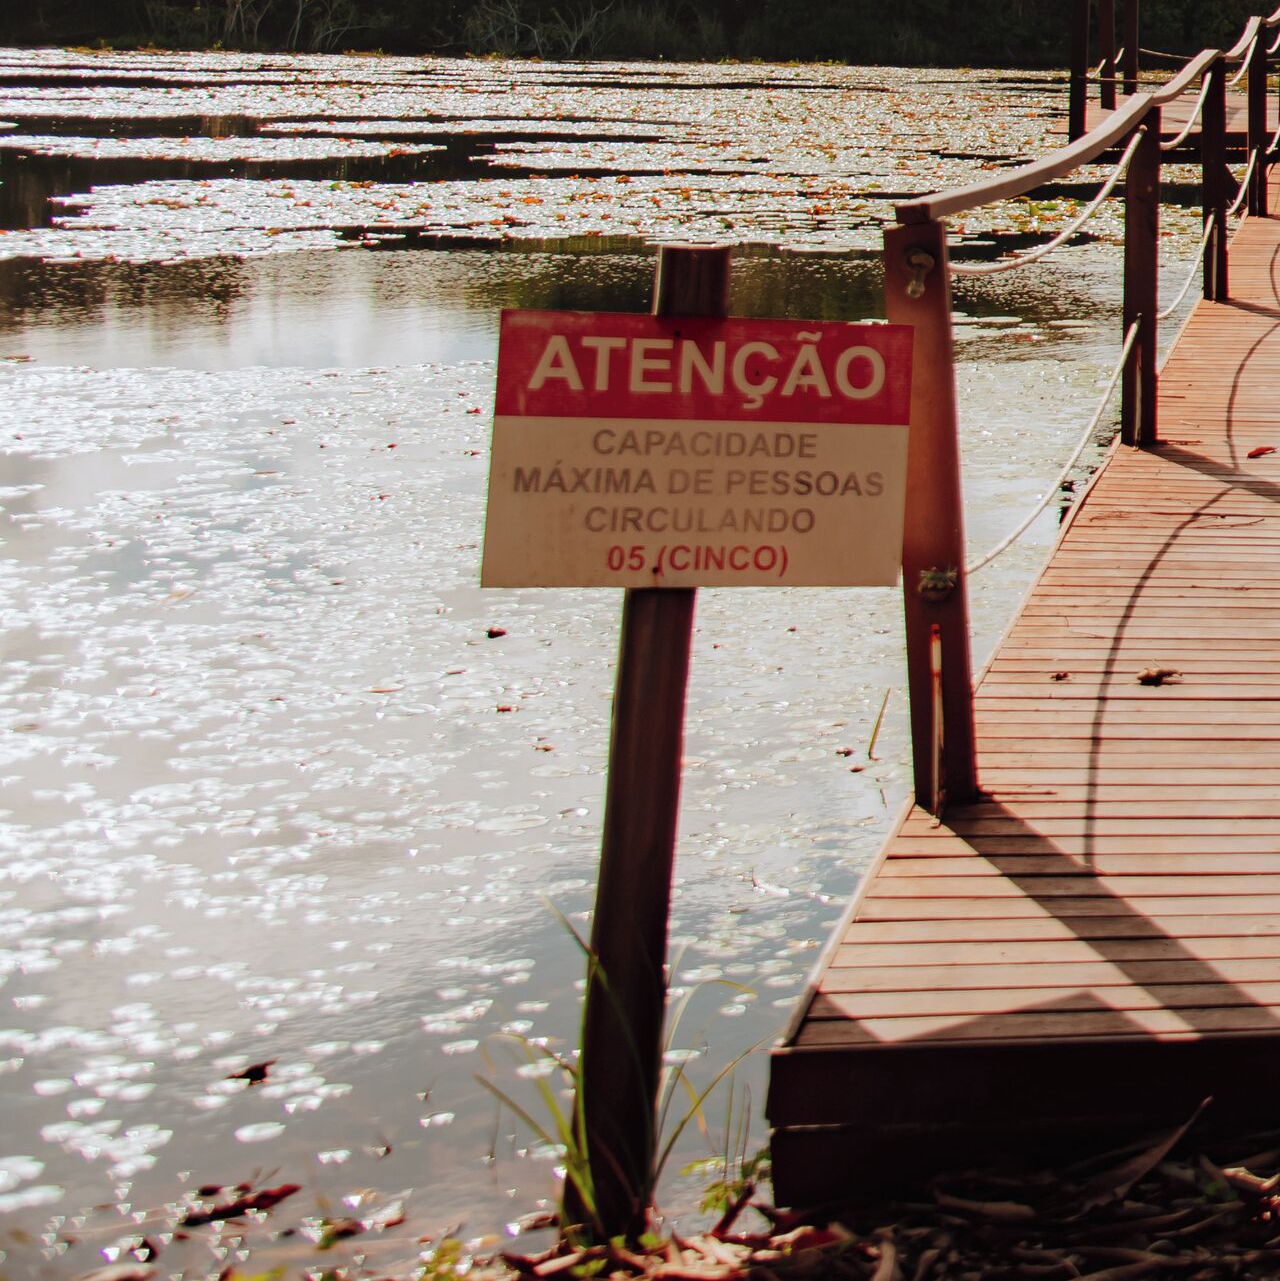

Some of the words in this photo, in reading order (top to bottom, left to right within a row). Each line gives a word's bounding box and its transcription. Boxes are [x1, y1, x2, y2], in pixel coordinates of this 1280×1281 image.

[527, 331, 887, 409] ATENÇÃO
[593, 429, 818, 459] CAPACIDADE
[513, 460, 656, 495] MÁXIMA
[668, 468, 713, 495] DE
[726, 469, 885, 497] PESSOAS
[584, 506, 816, 534] CIRCULANDO
[607, 545, 645, 572] 05
[656, 544, 789, 577] (CINCO)
